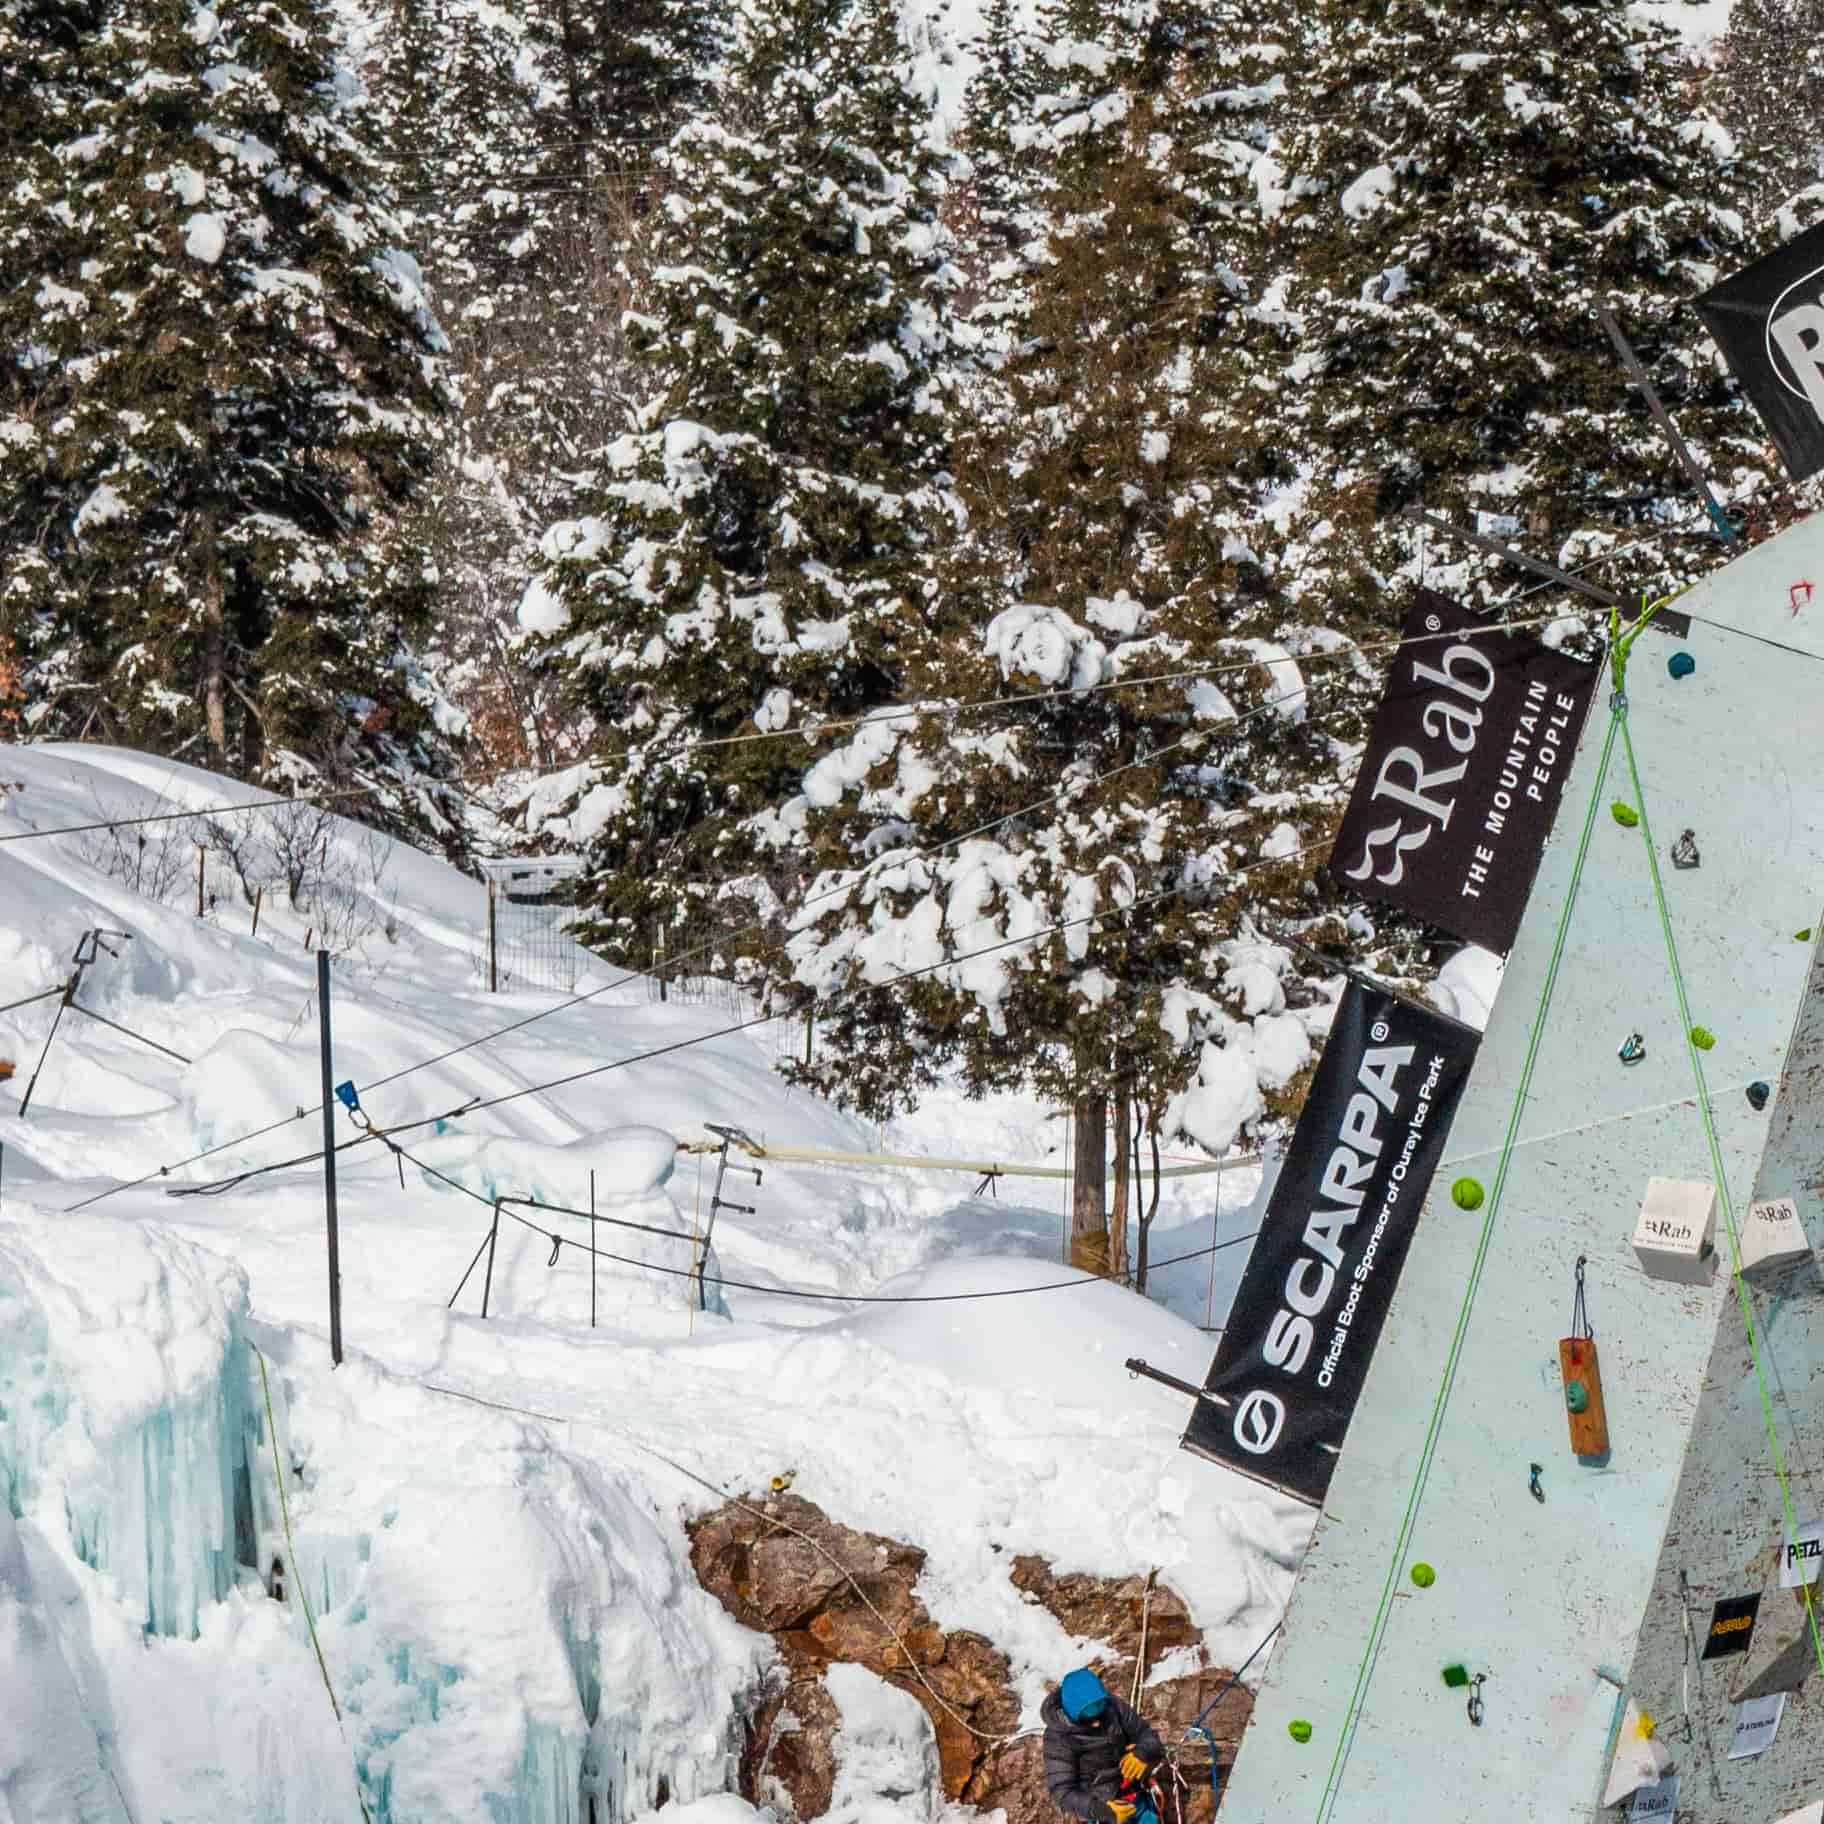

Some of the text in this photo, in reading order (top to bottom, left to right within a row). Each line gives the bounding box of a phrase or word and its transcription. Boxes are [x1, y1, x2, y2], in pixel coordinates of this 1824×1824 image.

[1371, 645, 1495, 831] Rab
[1462, 680, 1548, 898] THE MOUNTAIN
[1527, 694, 1575, 802] PEOPLE
[1262, 1044, 1417, 1373] SCARPA
[1318, 1055, 1445, 1387] Official Boot Sponsor of Ouray Ice Park
[1659, 1221, 1691, 1239] Rab
